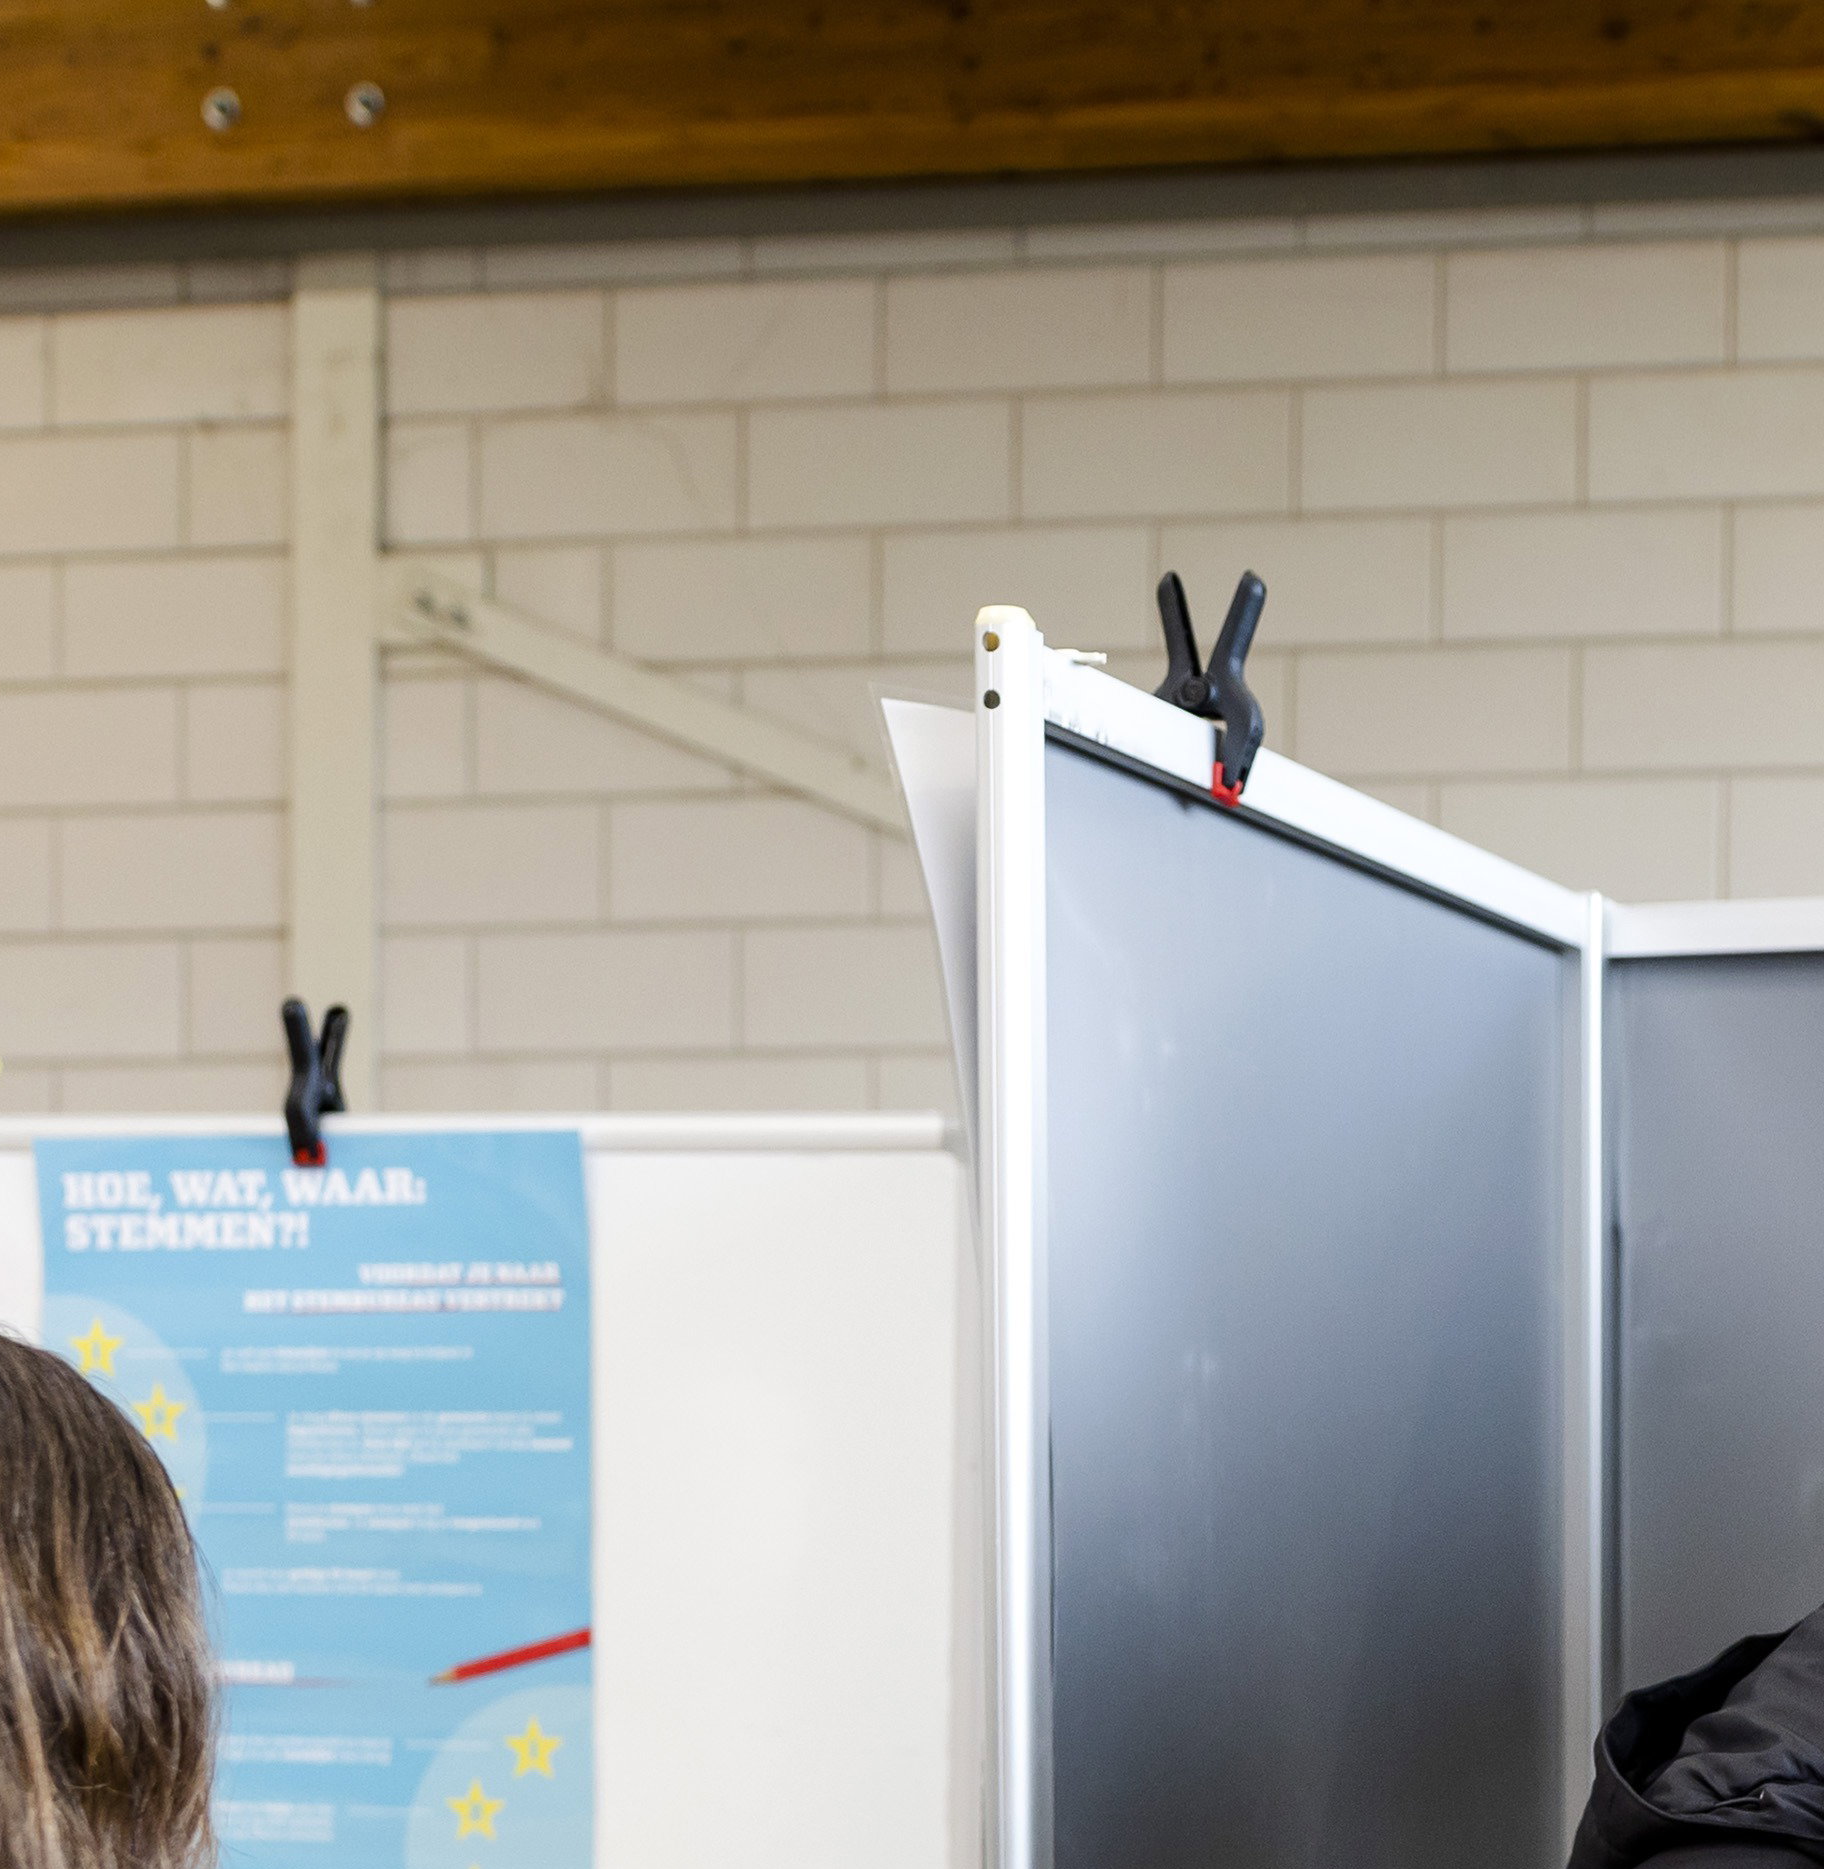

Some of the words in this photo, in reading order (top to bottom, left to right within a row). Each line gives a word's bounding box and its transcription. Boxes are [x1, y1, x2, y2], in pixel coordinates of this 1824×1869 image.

[62, 1170, 162, 1213] HOE,
[170, 1168, 273, 1212] WAT,
[281, 1166, 427, 1206] WAAR:
[64, 1210, 311, 1251] STEMMEN?!
